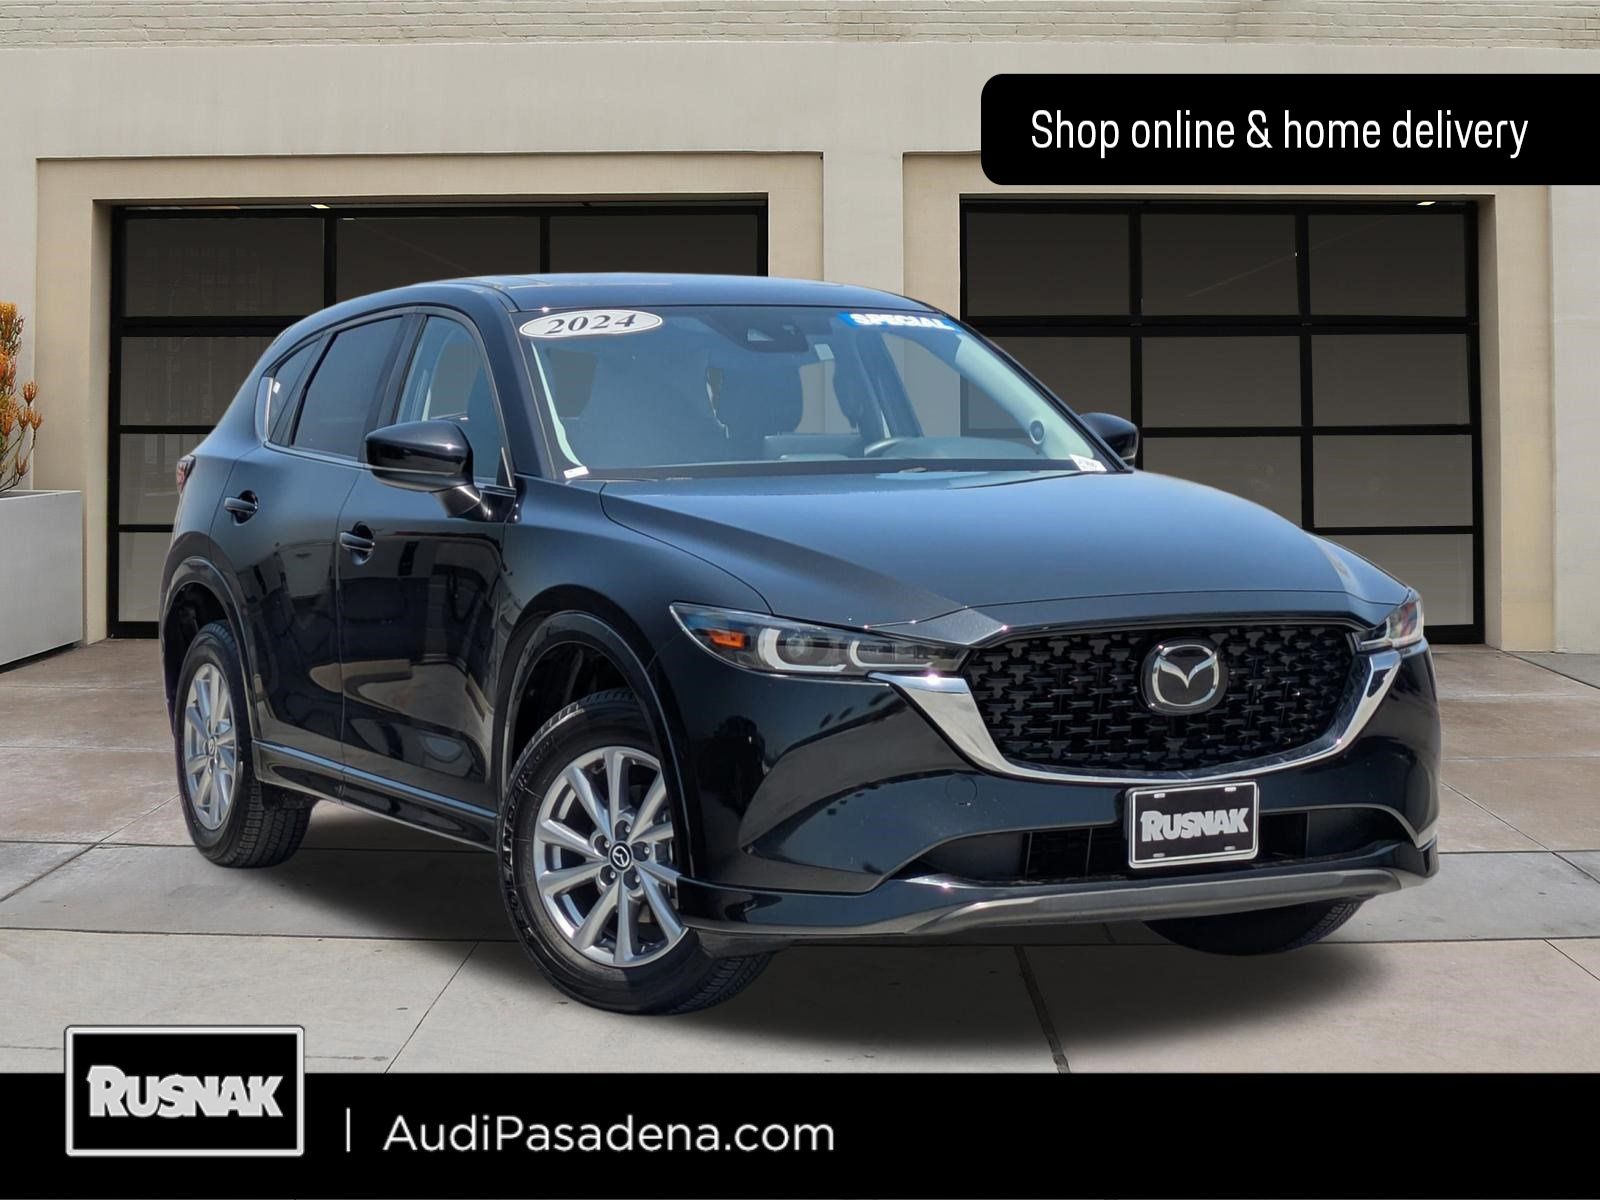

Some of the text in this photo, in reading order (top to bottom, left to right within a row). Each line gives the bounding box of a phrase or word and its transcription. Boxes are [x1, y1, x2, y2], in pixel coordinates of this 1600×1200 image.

[544, 313, 637, 335] 2024
[849, 312, 956, 331] SPECIAL
[1139, 807, 1250, 843] RUSNAK
